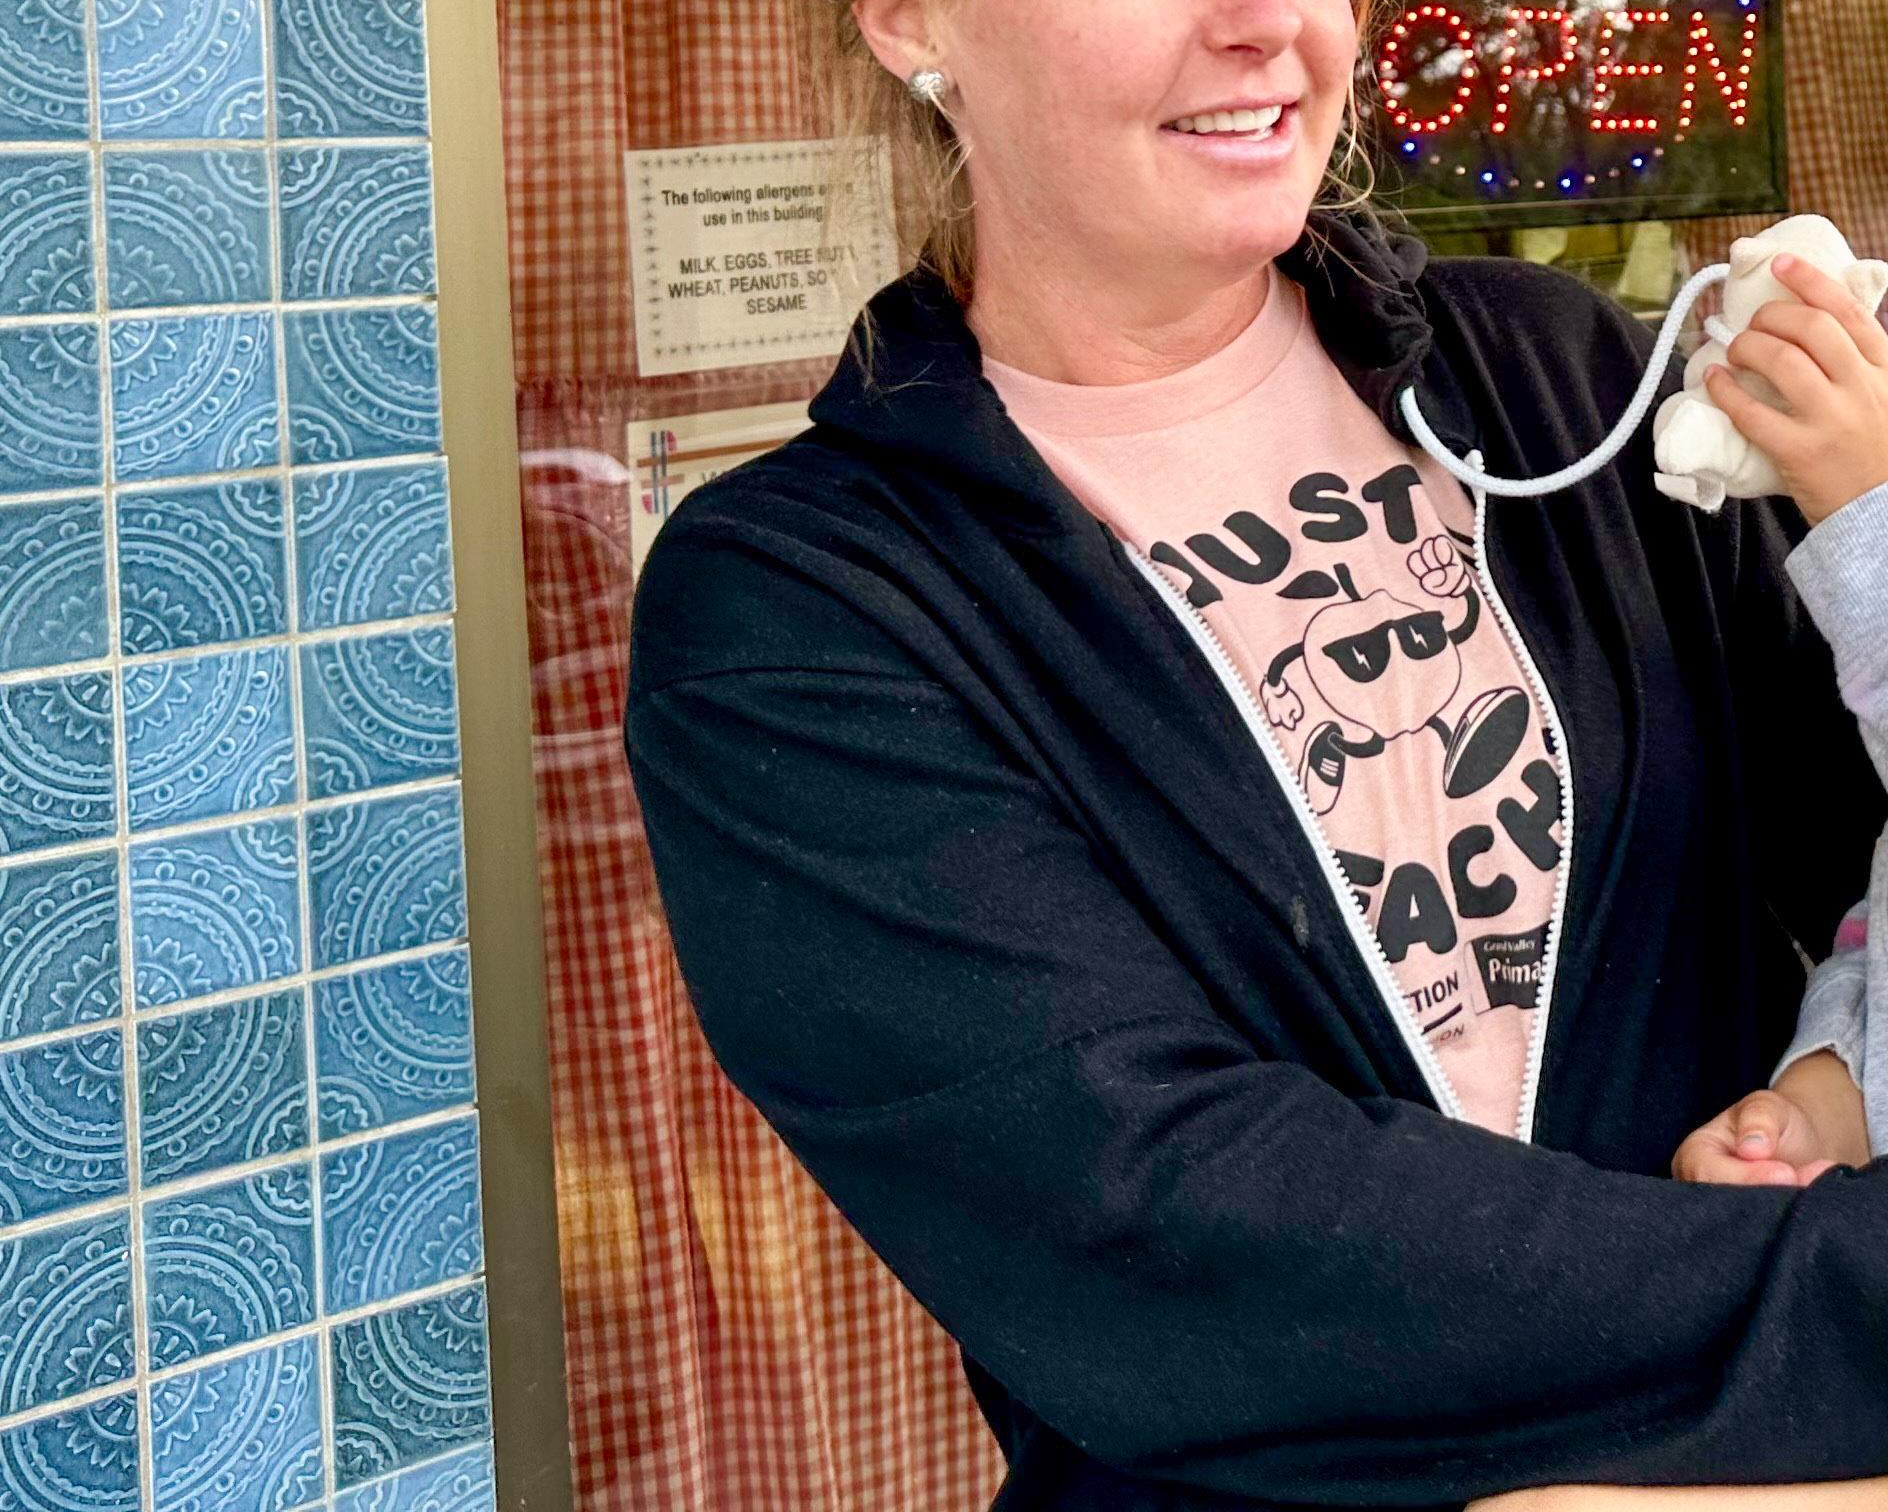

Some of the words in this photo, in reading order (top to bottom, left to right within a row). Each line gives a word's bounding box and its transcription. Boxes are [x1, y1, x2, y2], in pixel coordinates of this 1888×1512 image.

[1378, 2, 1760, 135] OPEN
[662, 190, 689, 205] The
[693, 188, 752, 204] following
[756, 184, 814, 201] allergens
[703, 212, 727, 226] use
[731, 210, 743, 224] in
[747, 207, 770, 223] this
[774, 205, 823, 222] building
[775, 248, 813, 266] TREE
[747, 293, 808, 315] SESAME
[1403, 970, 1460, 1013] TION
